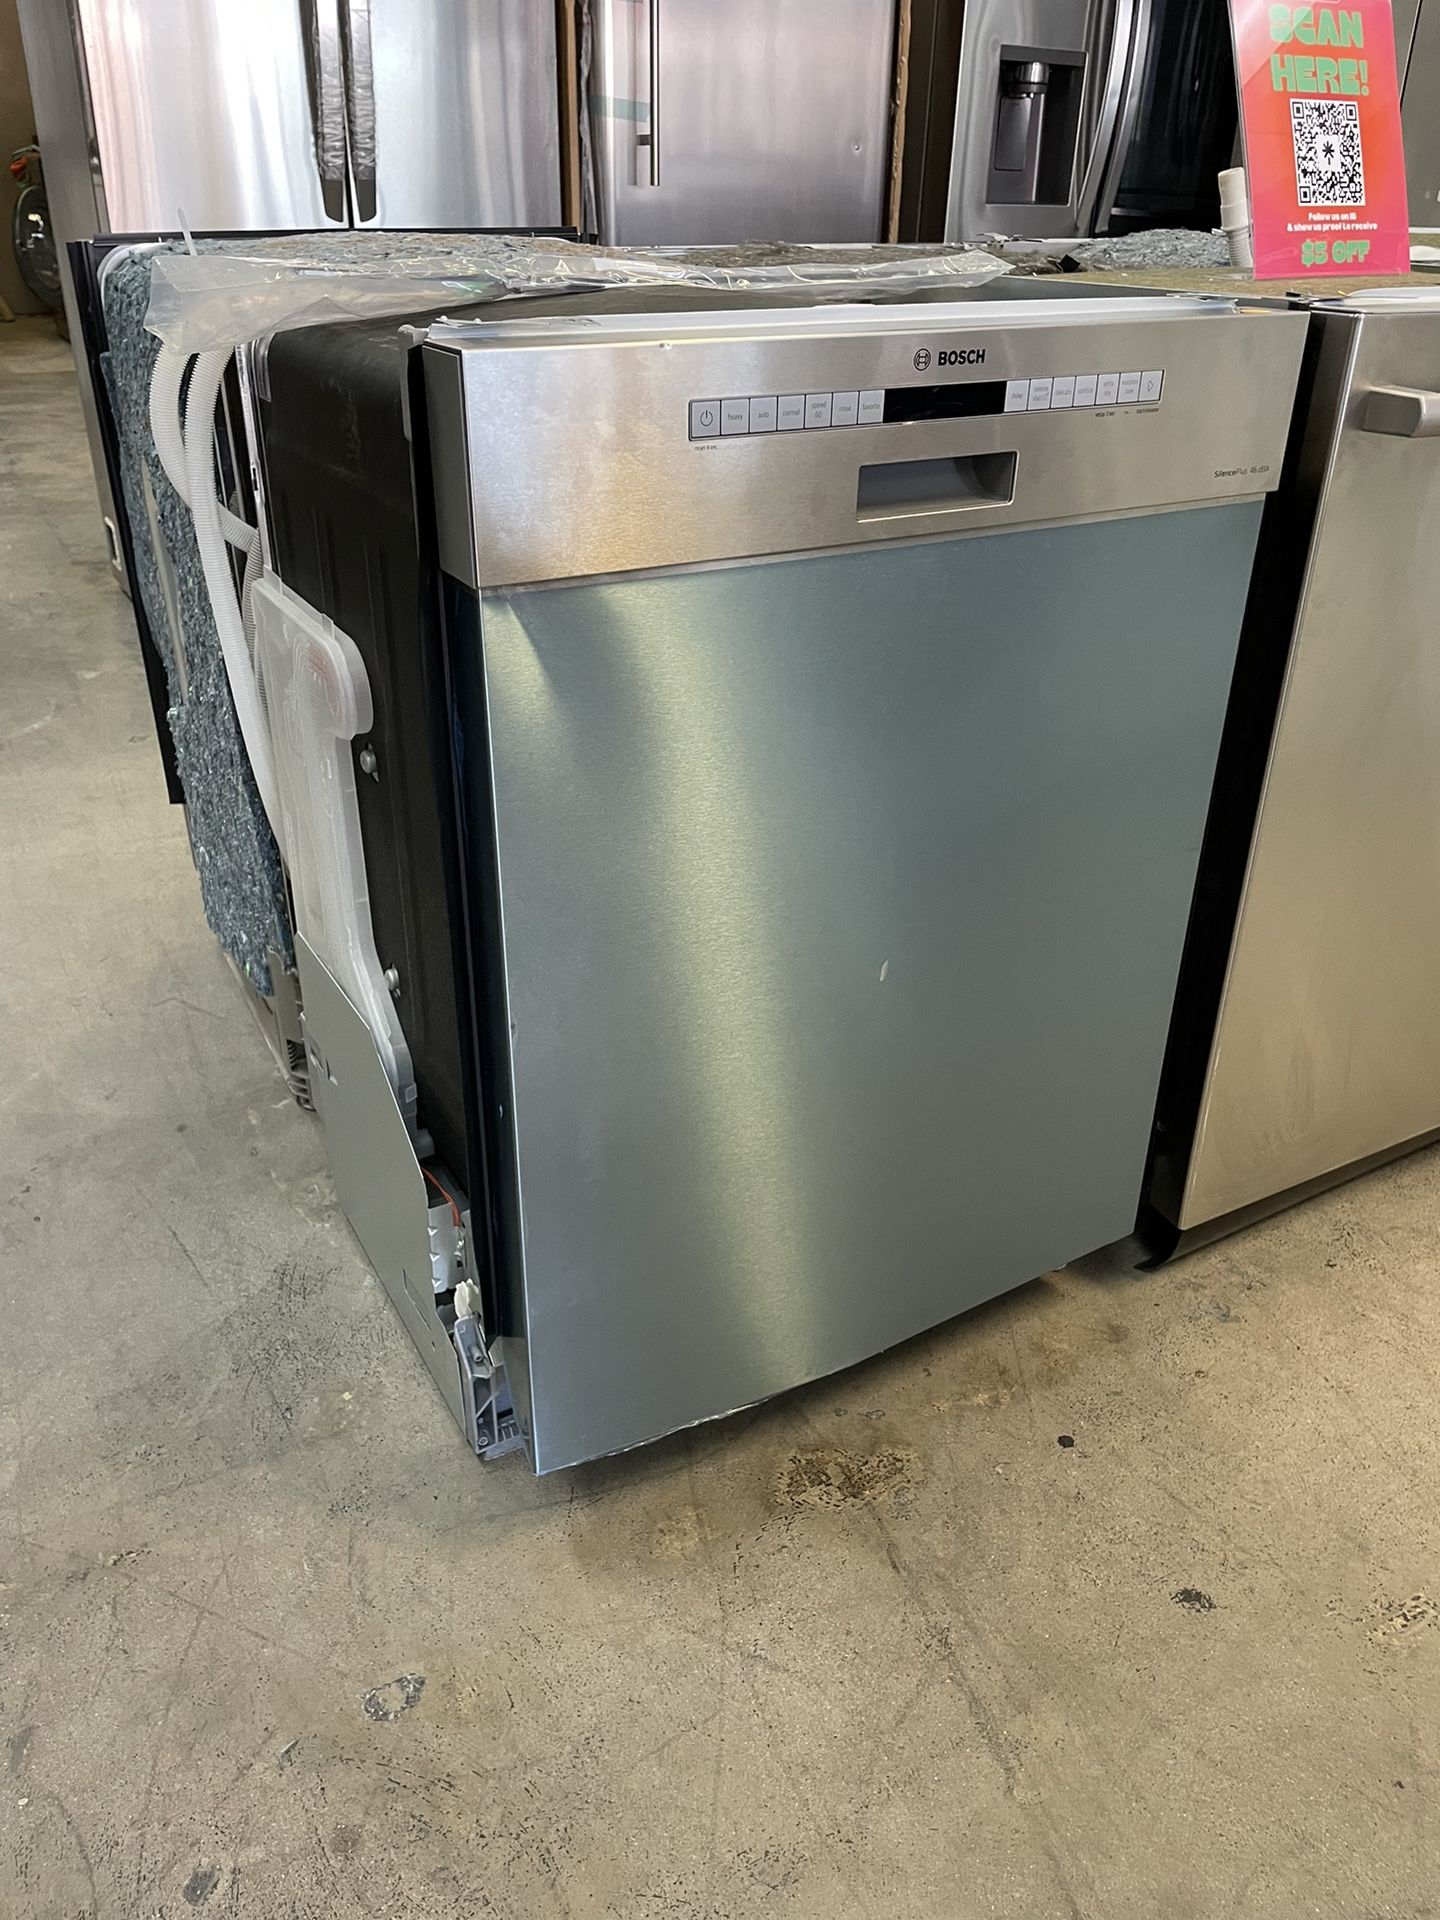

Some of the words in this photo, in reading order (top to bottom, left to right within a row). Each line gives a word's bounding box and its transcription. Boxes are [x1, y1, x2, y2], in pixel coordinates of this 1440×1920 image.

[1268, 5, 1364, 48] SCAN
[1270, 54, 1369, 96] HERE!
[1308, 212, 1331, 221] Follow
[1331, 213, 1340, 221] us
[1293, 223, 1312, 231] show
[1313, 223, 1322, 231] us
[1322, 222, 1342, 232] proof
[1342, 222, 1351, 231] to
[1351, 221, 1378, 230] receive
[1301, 238, 1328, 268] $5
[1332, 239, 1370, 263] OFF
[938, 349, 986, 366] BOSCH
[727, 412, 743, 421] heavy
